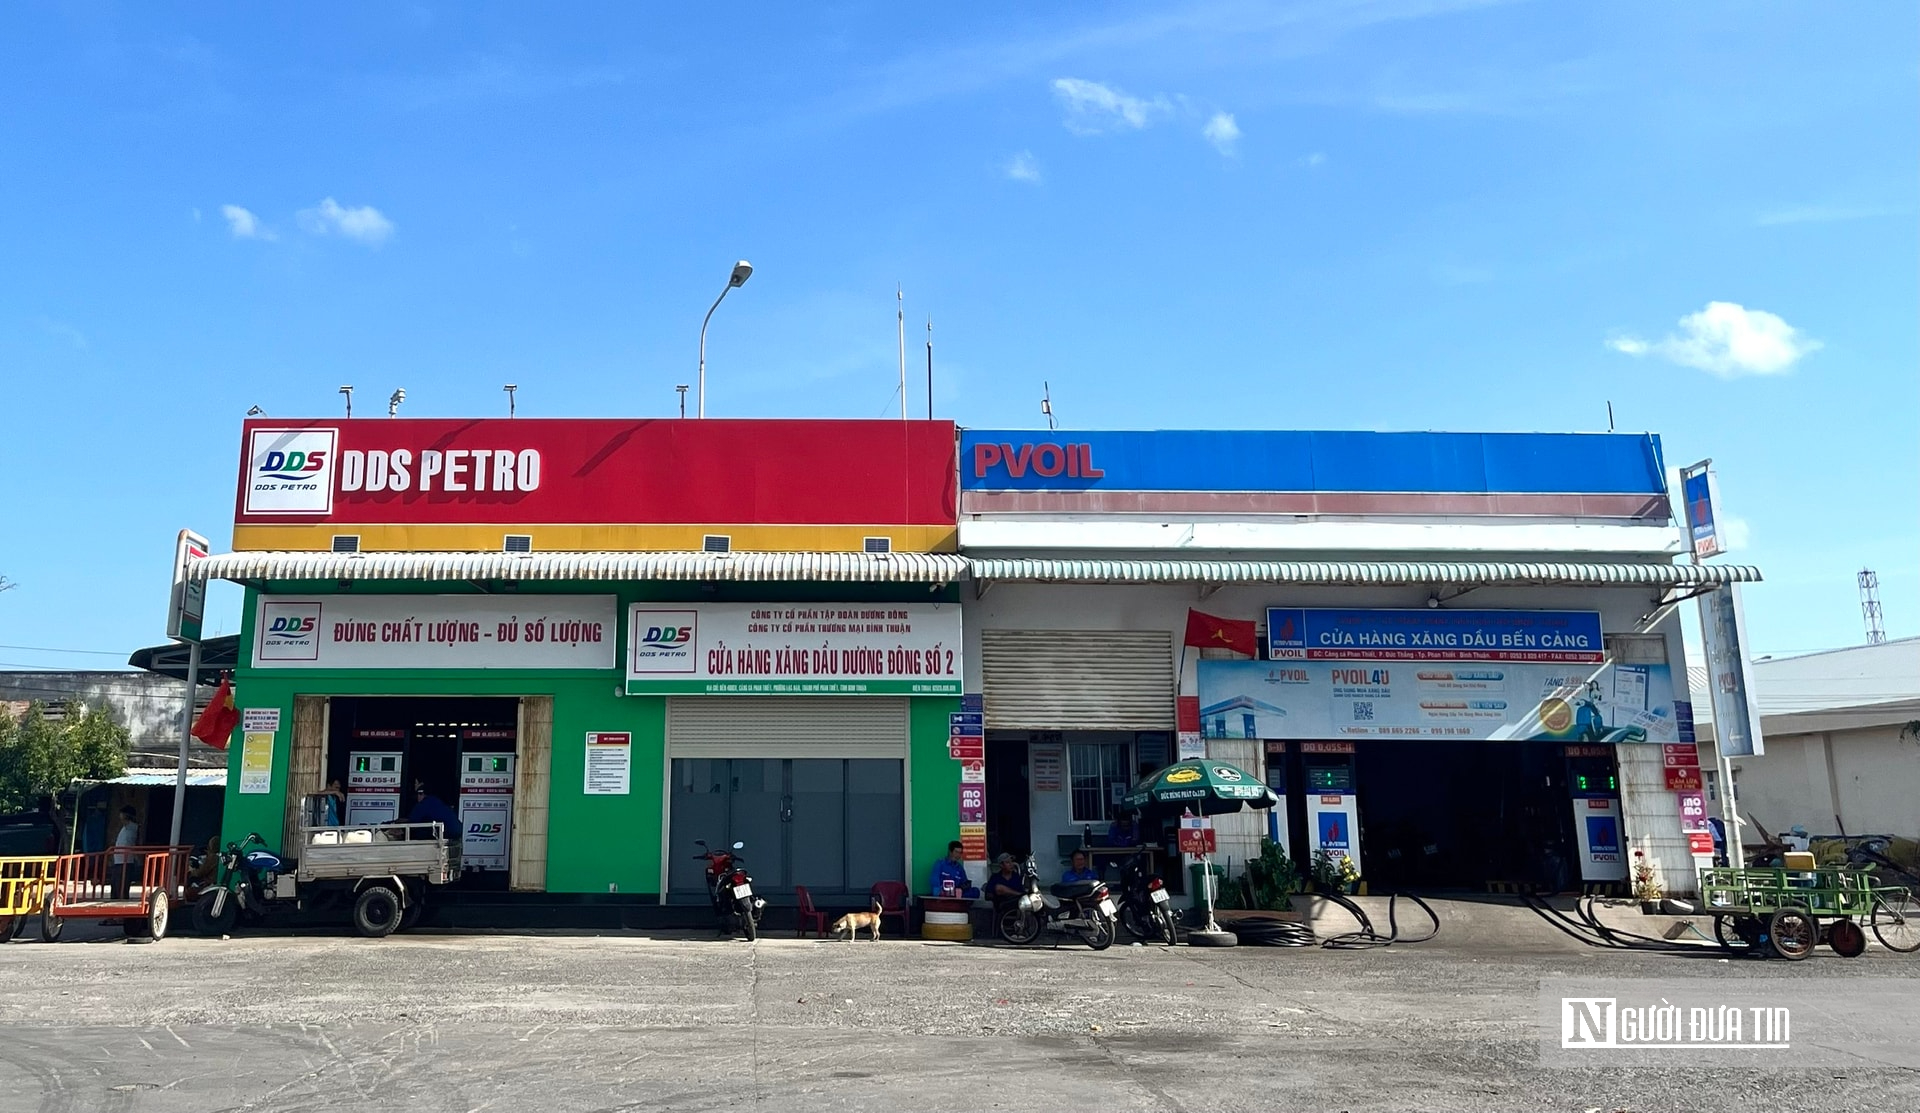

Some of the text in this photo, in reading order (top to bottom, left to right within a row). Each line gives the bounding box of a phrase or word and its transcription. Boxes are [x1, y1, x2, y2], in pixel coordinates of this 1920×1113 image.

[259, 451, 327, 471] DDS
[975, 442, 1105, 478] PVOIL
[341, 449, 541, 492] DDS PETRO
[280, 483, 318, 491] PETRO
[774, 610, 783, 619] TY
[269, 617, 316, 632] DDS
[333, 618, 376, 642] ĐÚNG
[381, 616, 423, 642] CHẤT
[427, 619, 479, 647] LƯỢNG
[497, 615, 519, 642] ĐỦ
[524, 616, 547, 642] SỐ
[550, 619, 602, 647] LƯỢNG
[771, 624, 780, 633] TY
[642, 627, 692, 643] DDS
[1320, 628, 1589, 648] CỬA HÀNG XĂNG DẦU BẾN CẢNG
[707, 640, 954, 675] CỬA HÀNG XĂNG DẦU DƯƠNG ĐÔNG SỐ 2
[1274, 650, 1303, 658] PVOIL
[1280, 669, 1310, 681] PVOIL
[1331, 669, 1390, 685] PVOIL4U
[468, 824, 502, 833] DDS
